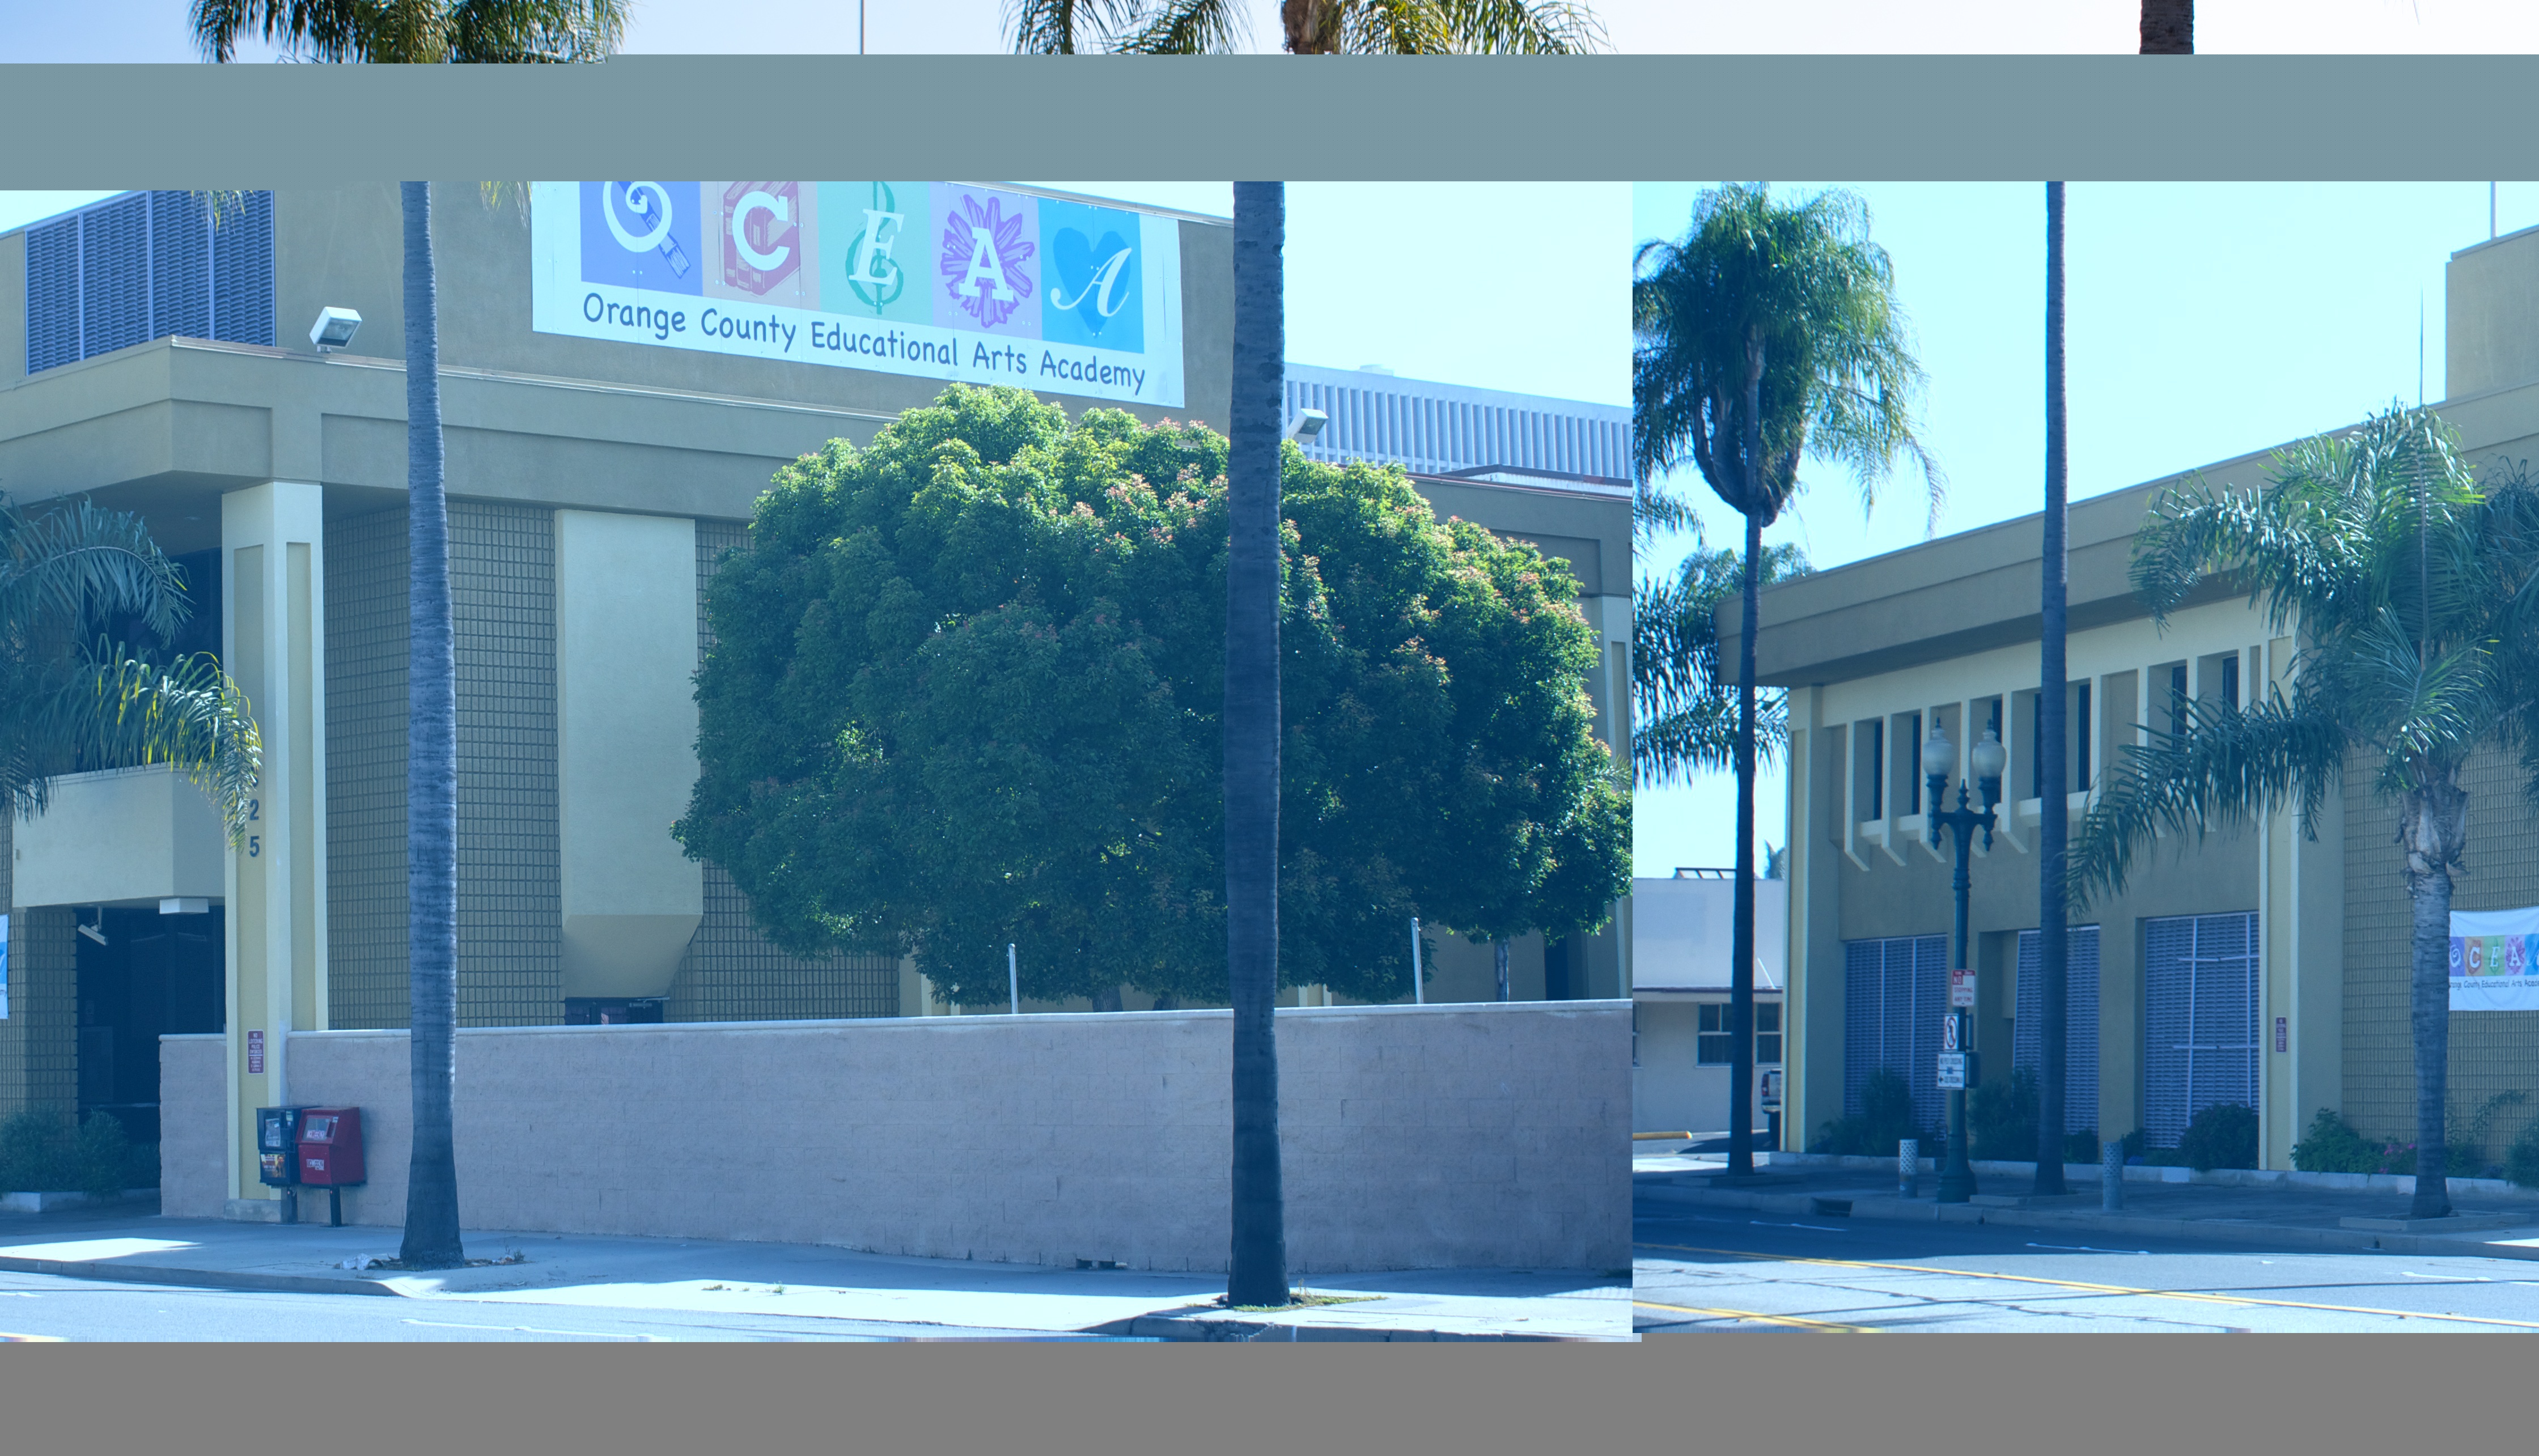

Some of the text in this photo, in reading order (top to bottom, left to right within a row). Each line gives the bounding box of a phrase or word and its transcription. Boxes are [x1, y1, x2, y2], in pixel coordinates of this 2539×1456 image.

[583, 292, 1146, 396] Orange County Educational Arts Academy
[2450, 982, 2461, 990] range
[2464, 980, 2480, 989] County
